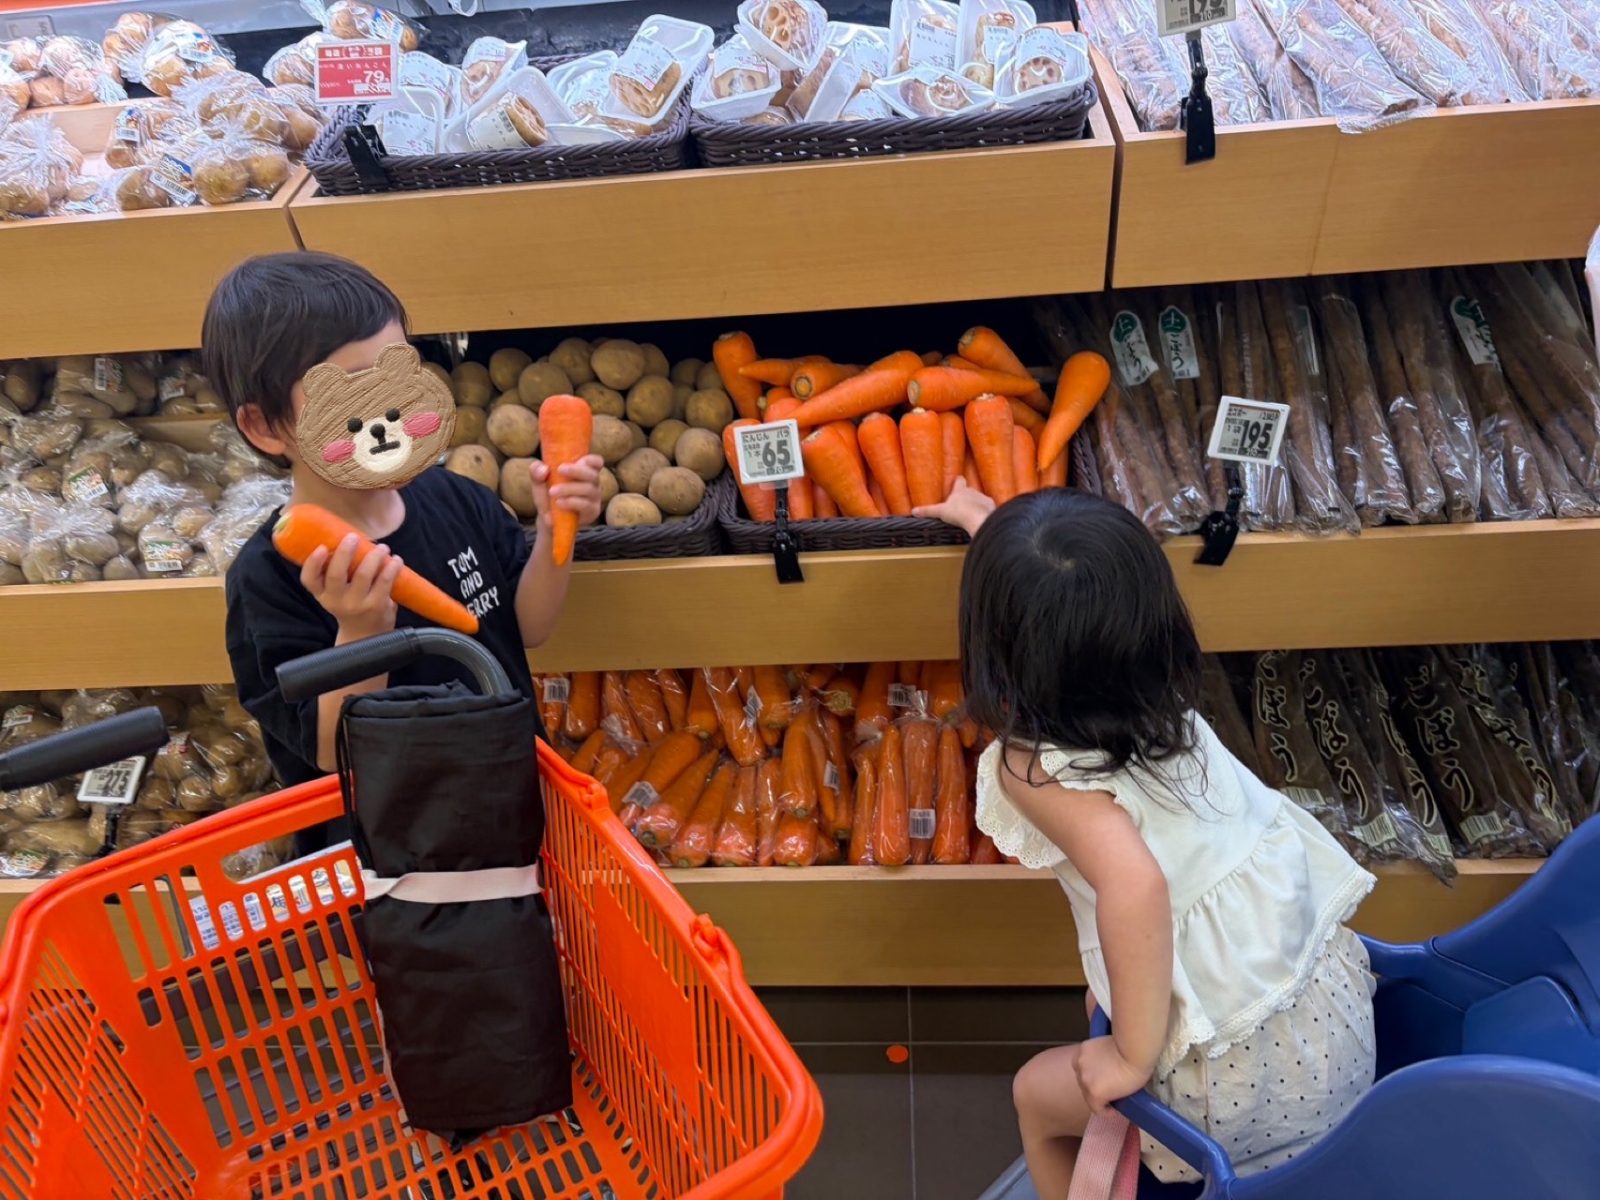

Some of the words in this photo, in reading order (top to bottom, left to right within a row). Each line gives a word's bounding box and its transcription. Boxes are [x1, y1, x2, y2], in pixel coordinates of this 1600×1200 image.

[363, 69, 385, 84] 79
[1240, 419, 1273, 449] 195
[762, 440, 791, 468] 65
[447, 546, 479, 579] TOM
[460, 570, 484, 599] AND
[466, 585, 500, 619] ERRY
[1404, 664, 1475, 812] ごぼう
